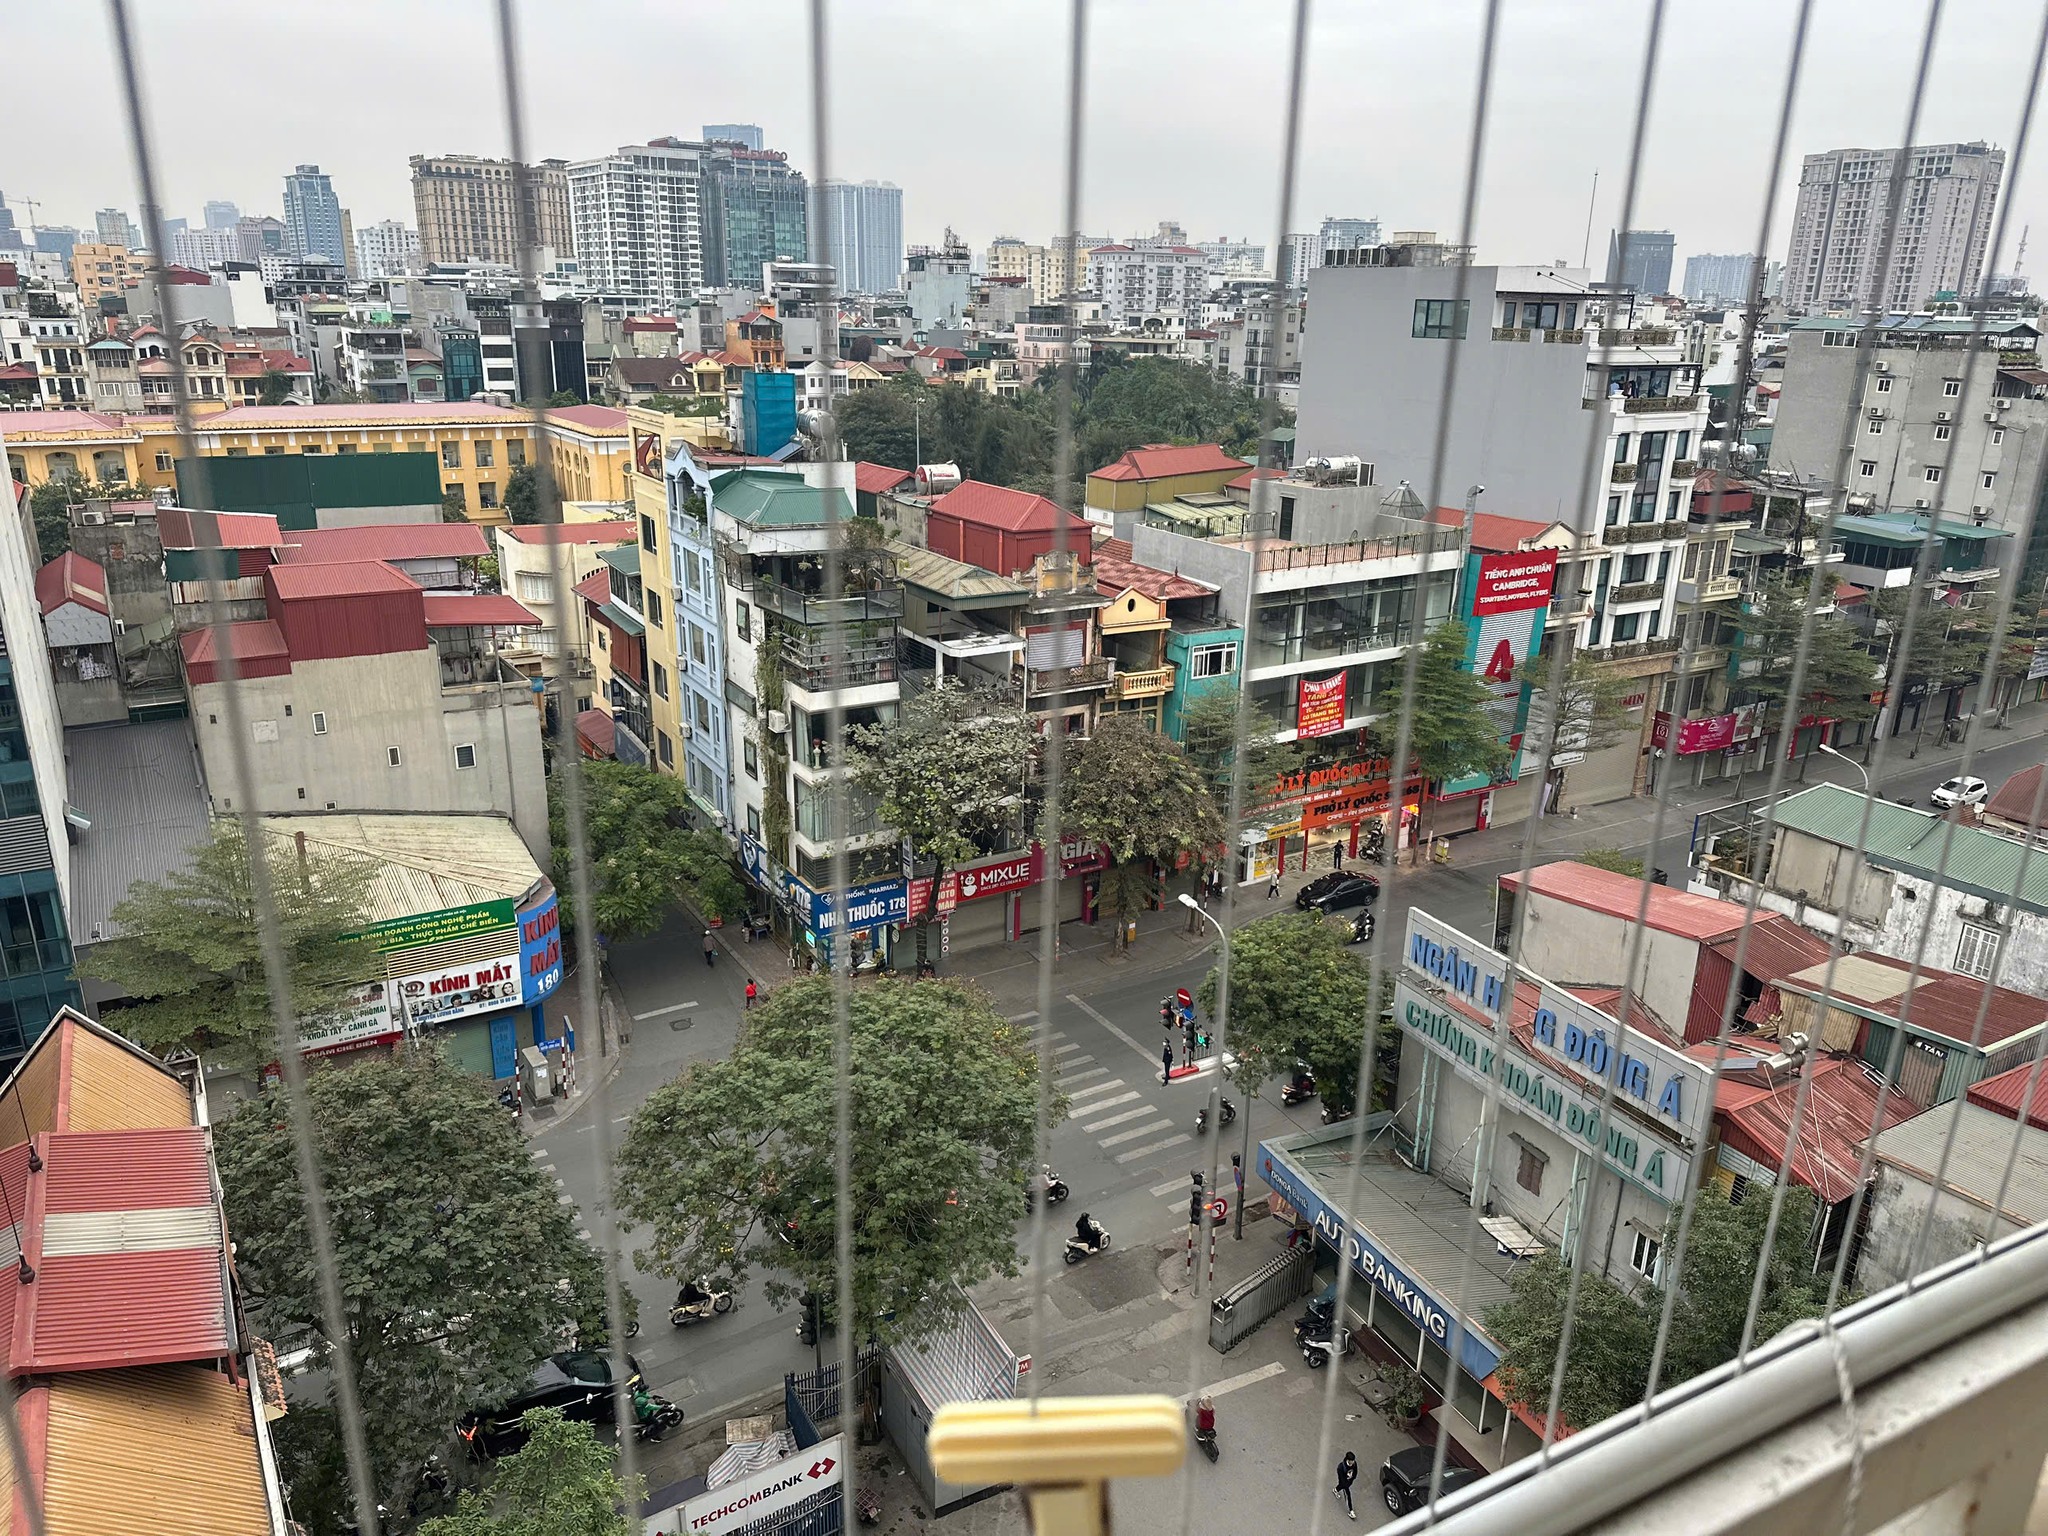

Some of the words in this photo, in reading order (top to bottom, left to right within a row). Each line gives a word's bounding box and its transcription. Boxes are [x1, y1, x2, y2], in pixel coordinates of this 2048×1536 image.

[1485, 567, 1508, 580] TIẾNG
[1509, 567, 1525, 577] ANH
[1526, 562, 1552, 574] CHUẨN
[1310, 761, 1349, 786] QUỐC
[1314, 800, 1336, 816] PHỞ
[1353, 790, 1382, 808] QUỐC
[981, 862, 1030, 886] MIXUE
[848, 897, 885, 922] THUỐC
[889, 896, 906, 910] 178
[384, 926, 414, 936] DOANH
[416, 920, 440, 930] CÔNG
[442, 916, 464, 926] NGHỆ
[466, 911, 490, 922] PHẨM
[410, 930, 434, 940] THỰC
[436, 924, 458, 935] PHẨM
[460, 920, 478, 930] CHẾ
[479, 916, 499, 928] BIẾN
[524, 903, 558, 944] KÍNH
[430, 975, 470, 995] KÍNH
[476, 962, 512, 986] MẮT
[538, 968, 558, 994] 180
[308, 1030, 328, 1041] KHOAI
[368, 1018, 378, 1027] GÀ
[1411, 932, 1478, 997] NGÂN
[1658, 1072, 1685, 1122] Á
[1406, 1000, 1476, 1066] CHỨNG
[1643, 1150, 1666, 1188] Á
[1292, 1188, 1308, 1210] Bank
[1315, 1210, 1360, 1260] AUTO
[1362, 1250, 1446, 1338] BANKING
[691, 1472, 803, 1530] TECHCOMBANK
